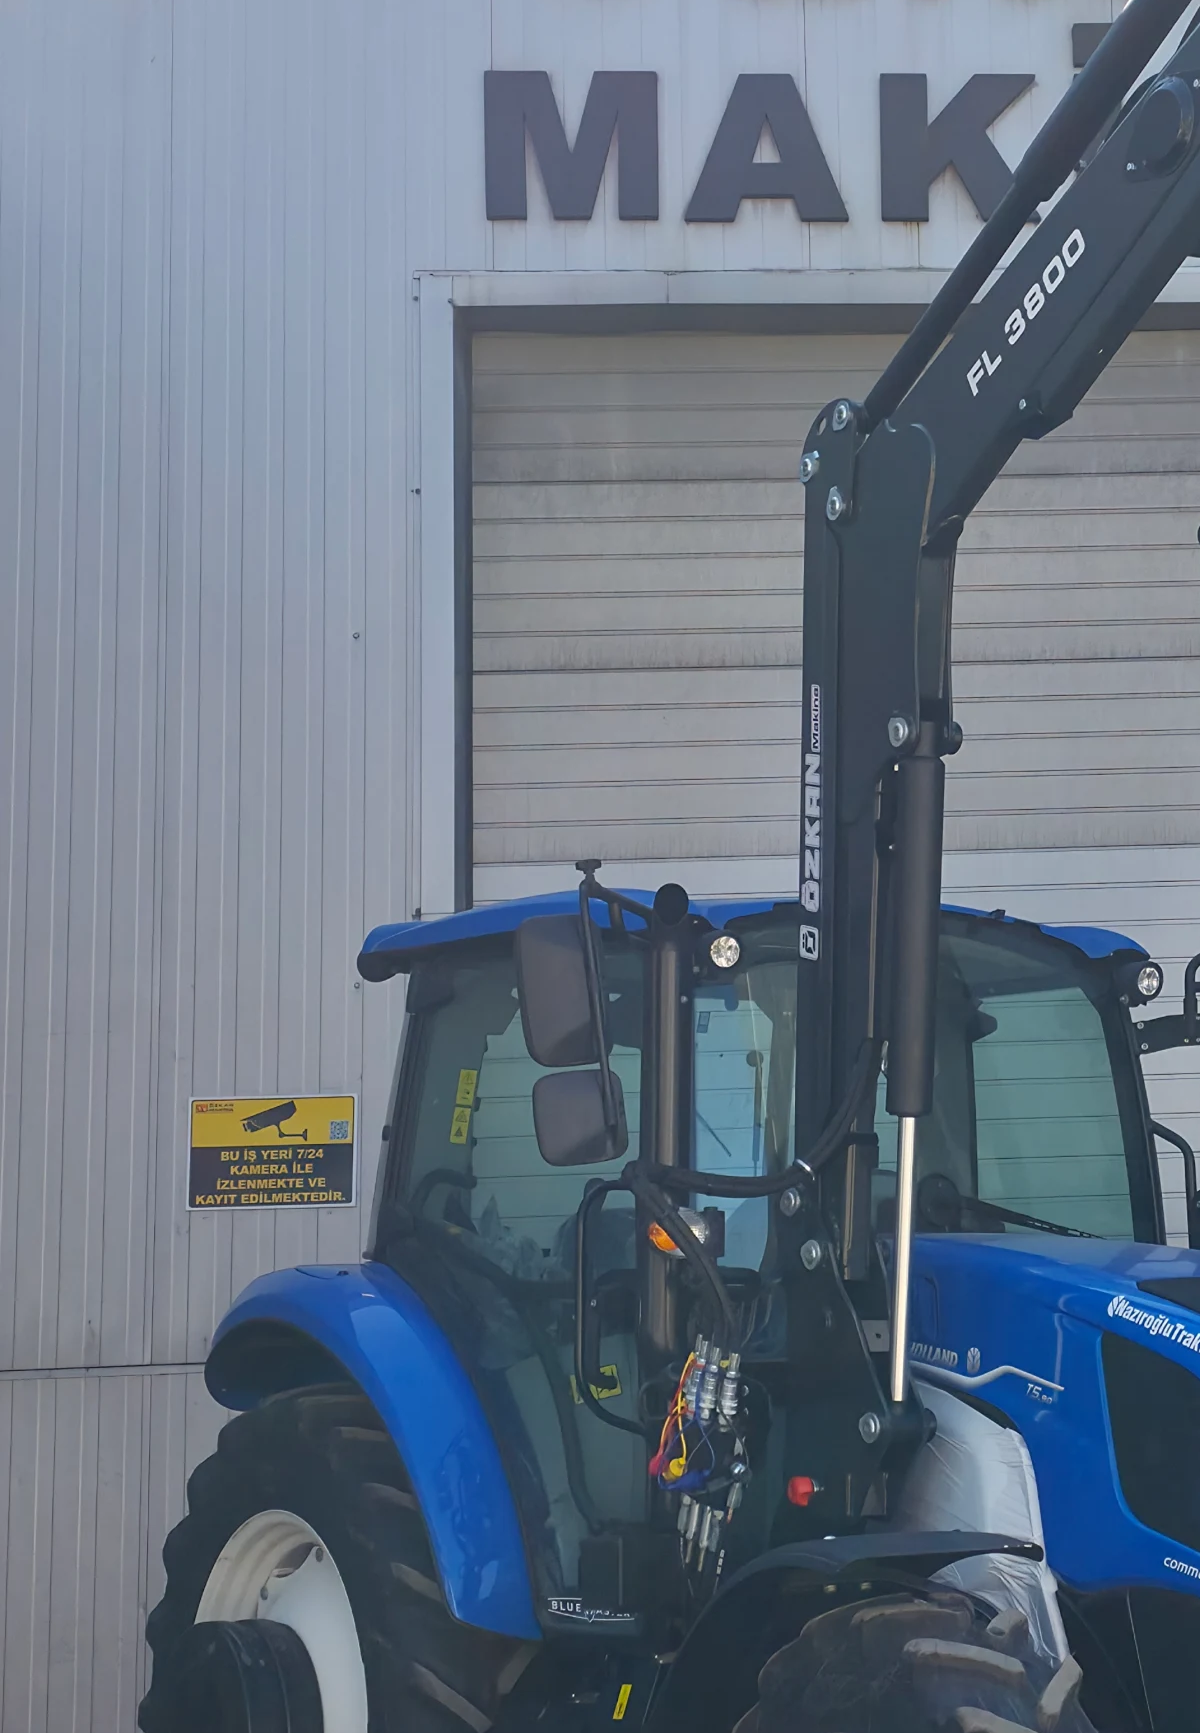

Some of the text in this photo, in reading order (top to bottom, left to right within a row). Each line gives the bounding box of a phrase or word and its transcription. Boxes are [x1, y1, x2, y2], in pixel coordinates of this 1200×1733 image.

[966, 228, 1086, 397] FL 3800
[801, 753, 821, 913] ÖZKAN
[220, 1148, 324, 1163] BU İŞ YERİ 7/24
[230, 1161, 313, 1176] KAMERA İLE
[216, 1177, 326, 1190] İZLENMEKTE VE
[195, 1194, 237, 1205] KAYIT
[551, 1600, 582, 1613] BLUE
